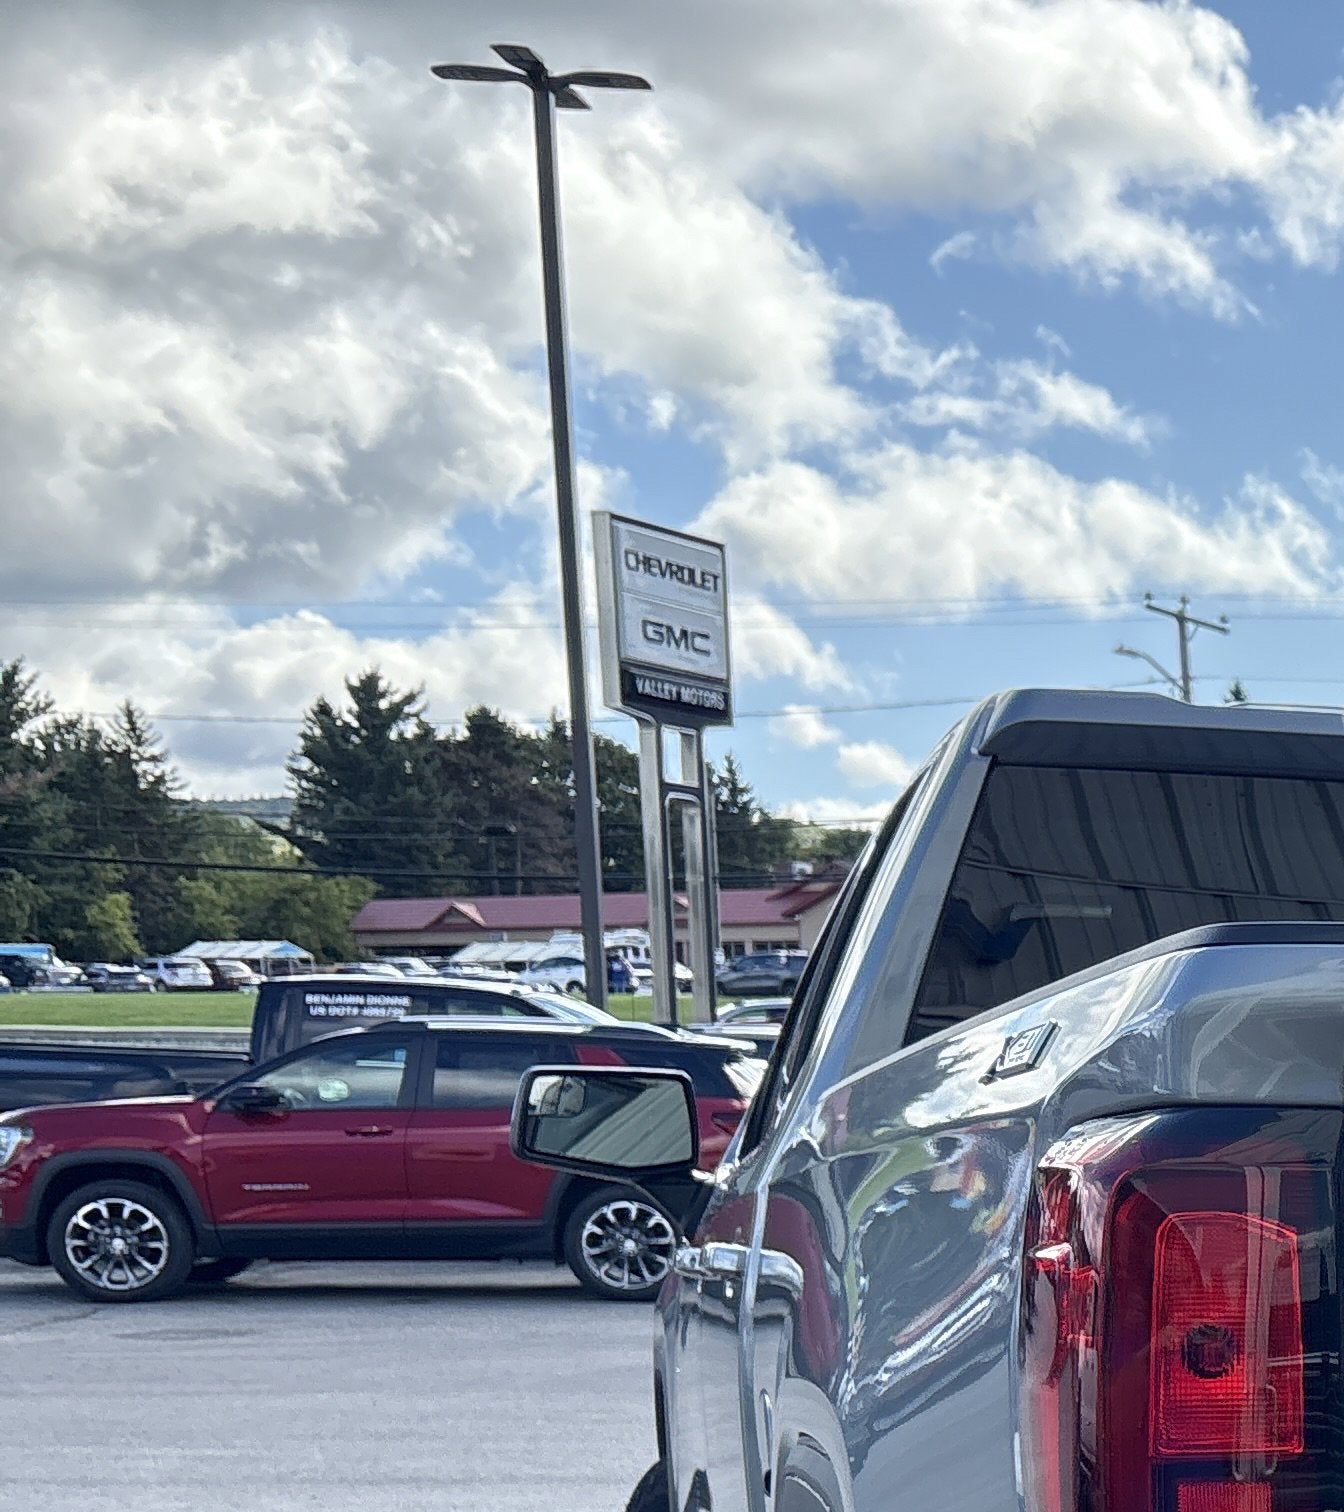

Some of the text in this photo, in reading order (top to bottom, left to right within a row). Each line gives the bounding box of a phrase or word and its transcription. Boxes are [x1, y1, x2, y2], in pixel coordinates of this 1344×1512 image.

[624, 550, 720, 593] CHEVROLET
[641, 619, 711, 657] GMC
[635, 676, 725, 710] VALLEY MOTORS
